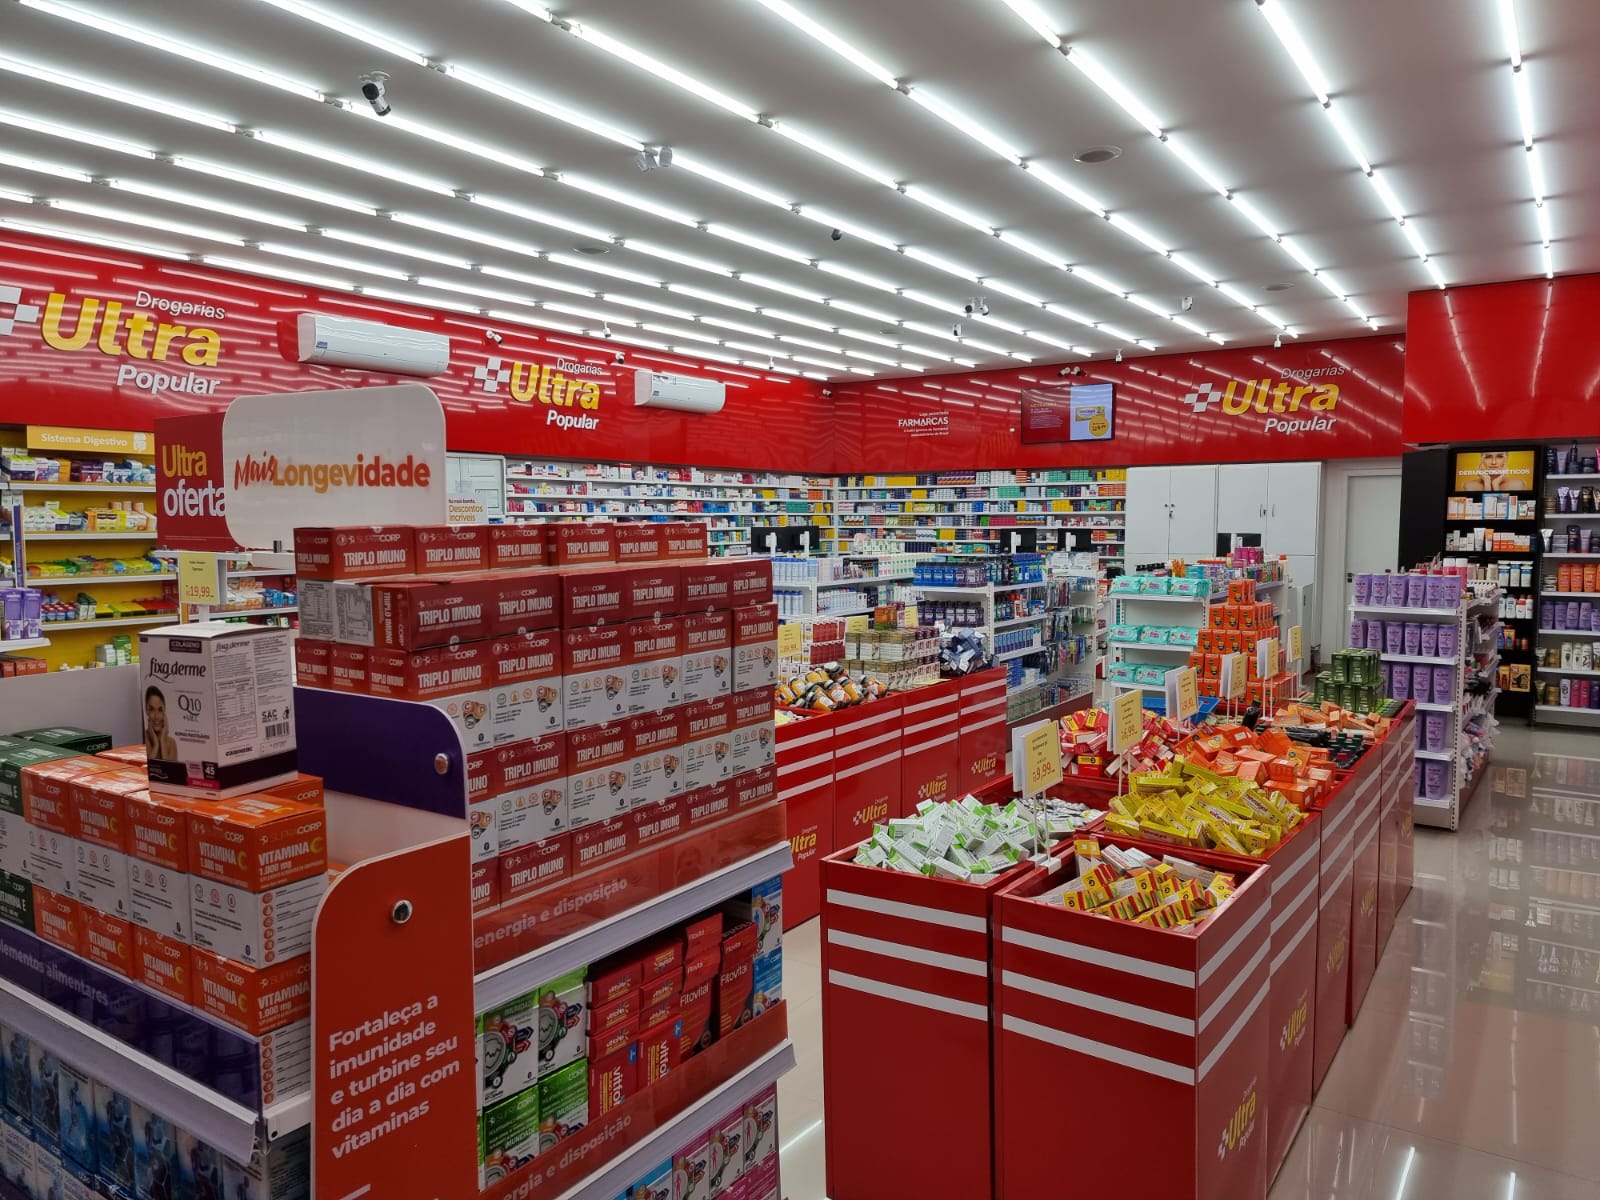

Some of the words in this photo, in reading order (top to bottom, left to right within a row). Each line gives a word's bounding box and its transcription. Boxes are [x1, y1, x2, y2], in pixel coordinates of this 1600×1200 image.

[135, 290, 226, 320] Drogarias
[41, 292, 222, 367] Ultra
[556, 358, 602, 376] Drogarias
[1282, 365, 1346, 380] Drogarias
[116, 364, 221, 395] Popular
[510, 361, 600, 411] Ultra
[1222, 378, 1341, 415] Ultra
[546, 410, 599, 431] Popular
[1264, 416, 1336, 435] Popular
[40, 432, 81, 445] Sistema
[83, 434, 128, 450] Digestivo
[162, 444, 208, 478] Ultra
[344, 551, 374, 566] TRIPLO
[377, 549, 406, 563] IMUNO
[426, 549, 452, 562] TRIPLO
[455, 547, 480, 560] IMUNO
[497, 544, 519, 556] TRIPLO
[521, 543, 541, 555] IMUNO
[567, 543, 587, 554] TRIPLO
[589, 541, 609, 552] IMUNO
[620, 543, 638, 553] TRIPLO
[640, 541, 658, 552] IMUNO
[633, 588, 653, 600] TRIPLO
[655, 585, 674, 597] IMUNO
[688, 584, 707, 596] TRIPLO
[709, 581, 727, 593] IMUNO
[733, 580, 746, 591] RIPLO
[499, 601, 525, 616] TRIPLO
[527, 596, 552, 610] IMUNO
[572, 596, 595, 609] TRIPLO
[597, 592, 619, 605] IMUNO
[418, 610, 449, 626] TRIPLO
[452, 604, 481, 620] IMUNO
[688, 631, 707, 643] TRIPLO
[709, 628, 726, 641] IMUNO
[741, 624, 756, 636] TRIPLO
[758, 621, 773, 633] IMUNO
[572, 649, 596, 664] TRIPLO
[598, 644, 621, 658] IMUNO
[634, 640, 653, 653] TRIPLO
[655, 635, 675, 649] IMUNO
[499, 659, 526, 675] TRIPLO
[528, 653, 553, 669] IMUNO
[418, 673, 448, 688] TRIPLO
[452, 665, 481, 681] IMUNO
[177, 694, 202, 716] Q10
[261, 709, 278, 720] SAC
[736, 706, 752, 719] TRIPLO
[753, 702, 771, 716] IMUNO
[689, 719, 707, 733] TRIPLO
[708, 714, 727, 729] IMUNO
[635, 732, 656, 747] TRIPLO
[657, 726, 678, 742] IMUNO
[576, 747, 601, 763] TRIPLO
[602, 742, 625, 757] IMUNO
[205, 765, 215, 776] 45
[504, 764, 530, 780] TRIPLO
[532, 758, 559, 775] IMUNO
[977, 757, 996, 774] Ultra
[468, 777, 488, 792] UNO
[926, 779, 947, 798] Ultra
[690, 804, 709, 819] TRIPLO
[711, 798, 729, 813] IMUNO
[862, 803, 888, 824] Ultra
[80, 808, 109, 832] VITAMINA
[109, 815, 118, 833] C
[638, 823, 658, 839] TRIPLO
[659, 815, 679, 832] IMUNO
[134, 824, 167, 848] VITAMINA
[167, 834, 177, 852] C
[580, 845, 602, 862] TRIPLO
[604, 835, 626, 852] IMUNO
[199, 841, 236, 865] VITAMINA
[237, 852, 248, 869] C
[258, 840, 310, 867] VITAMINA
[310, 837, 323, 853] C
[510, 868, 537, 886] TRIPLO
[538, 858, 563, 877] IMUNO
[472, 883, 490, 901] UNO
[475, 914, 537, 949] energia
[540, 910, 550, 922] e
[553, 877, 628, 918] disposição
[117, 941, 125, 958] C
[0, 942, 44, 974] lementos
[46, 960, 109, 1006] alimentares
[143, 955, 175, 980] VITAMINA
[175, 966, 184, 985] C
[720, 964, 748, 987] Fitovital
[202, 978, 237, 1003] VITAMINA
[237, 993, 248, 1012] C
[680, 983, 709, 1007] Fitovital
[329, 1001, 423, 1052] Fortaleça
[427, 995, 439, 1010] a
[1287, 1001, 1307, 1045] Ultra
[330, 1021, 436, 1080] imunidade
[330, 1090, 344, 1105] e
[348, 1053, 421, 1097] turbine
[425, 1036, 458, 1061] seu
[331, 1107, 364, 1132] dia
[369, 1099, 382, 1115] a
[386, 1081, 415, 1105] dia
[420, 1059, 460, 1089] com
[332, 1100, 430, 1159] vitaminas
[1229, 1091, 1257, 1150] Ultra
[504, 1172, 542, 1200] ergia
[546, 1165, 556, 1178] e
[559, 1116, 632, 1169] disposição
